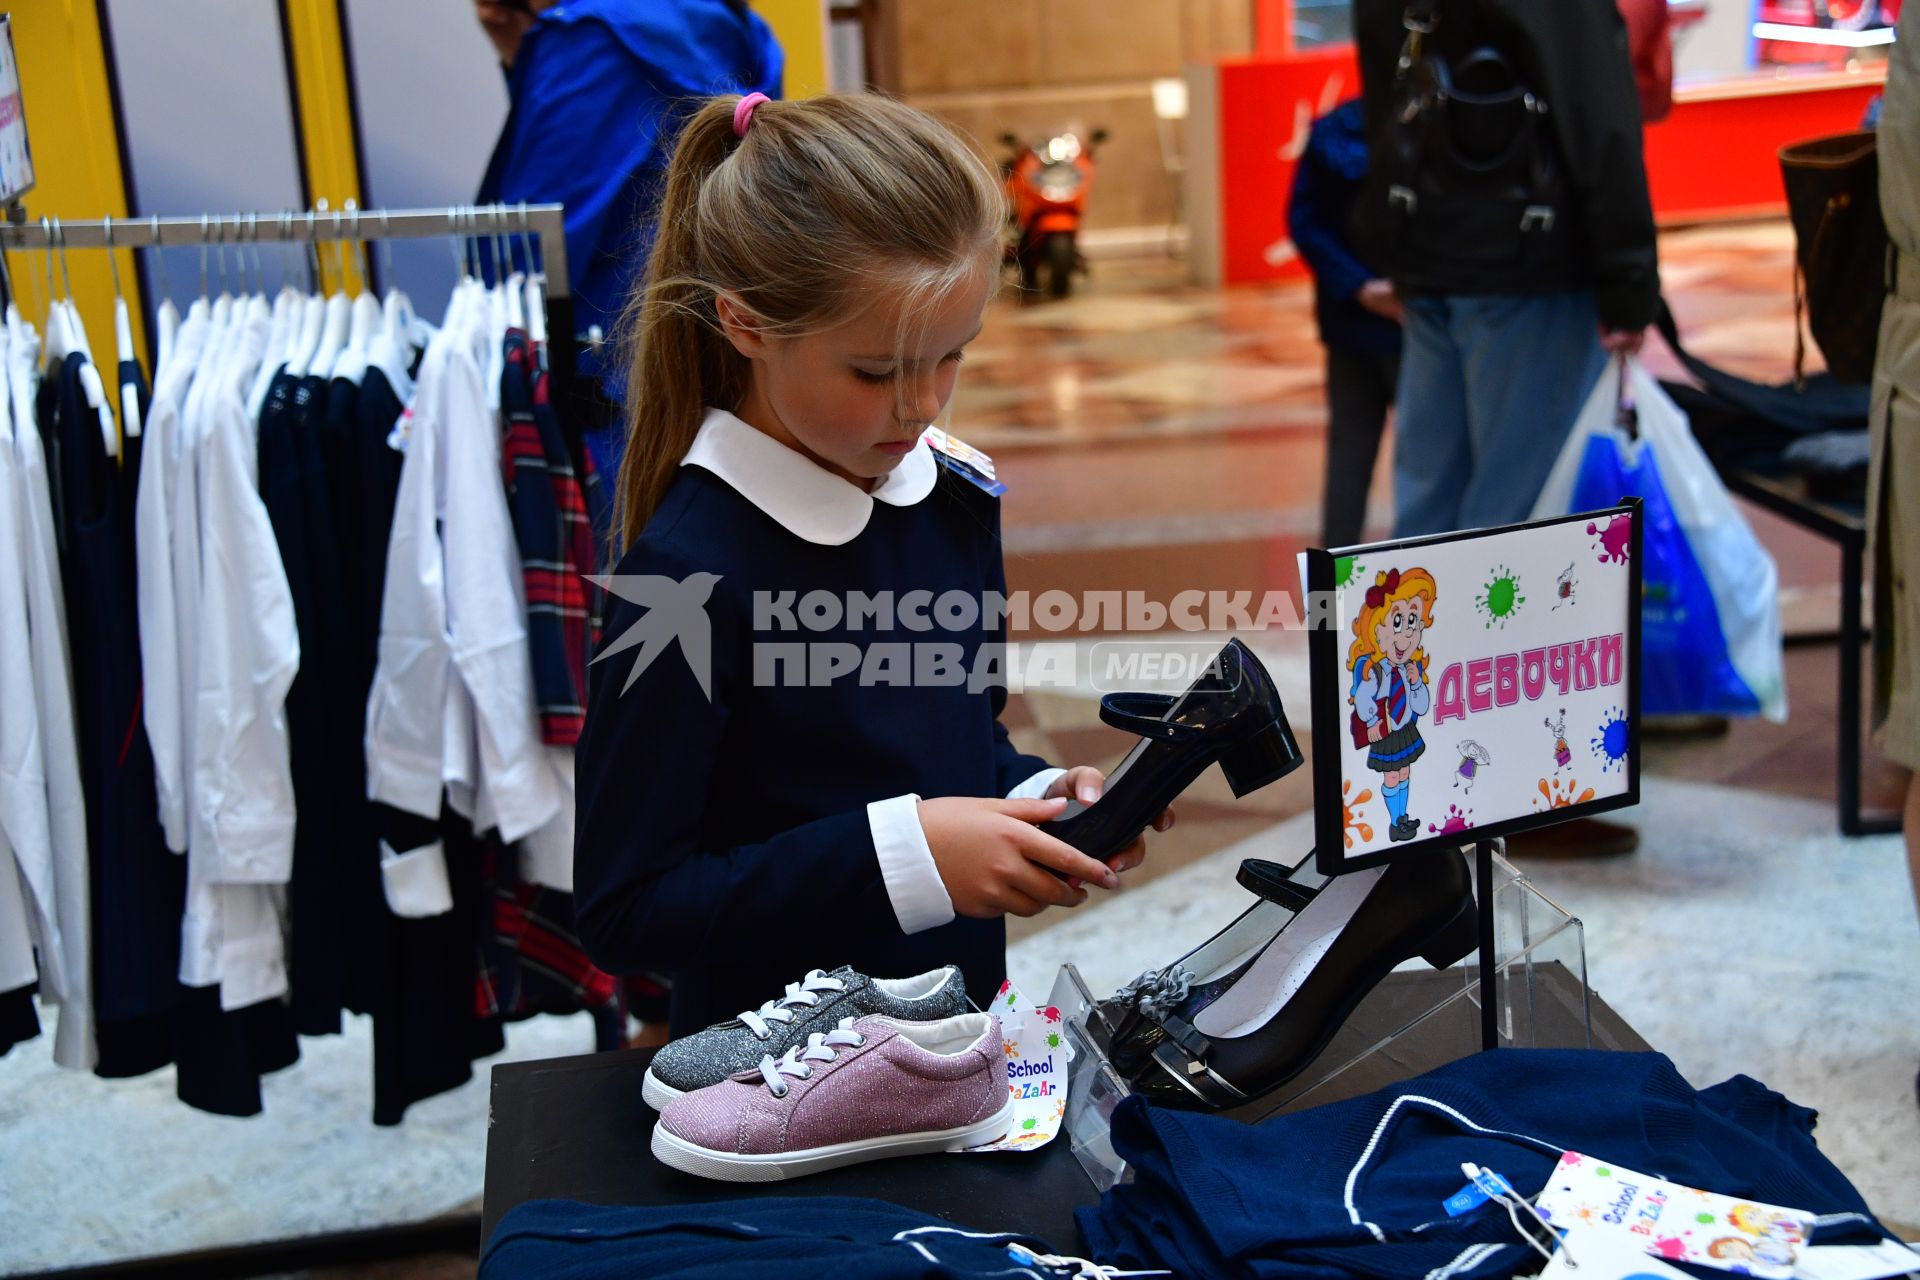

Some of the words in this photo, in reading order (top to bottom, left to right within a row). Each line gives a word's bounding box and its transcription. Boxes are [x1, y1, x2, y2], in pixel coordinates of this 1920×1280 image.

[1433, 633, 1624, 726] ДЕВОЧКИ
[1007, 1055, 1054, 1078] School
[1602, 1180, 1639, 1224] School
